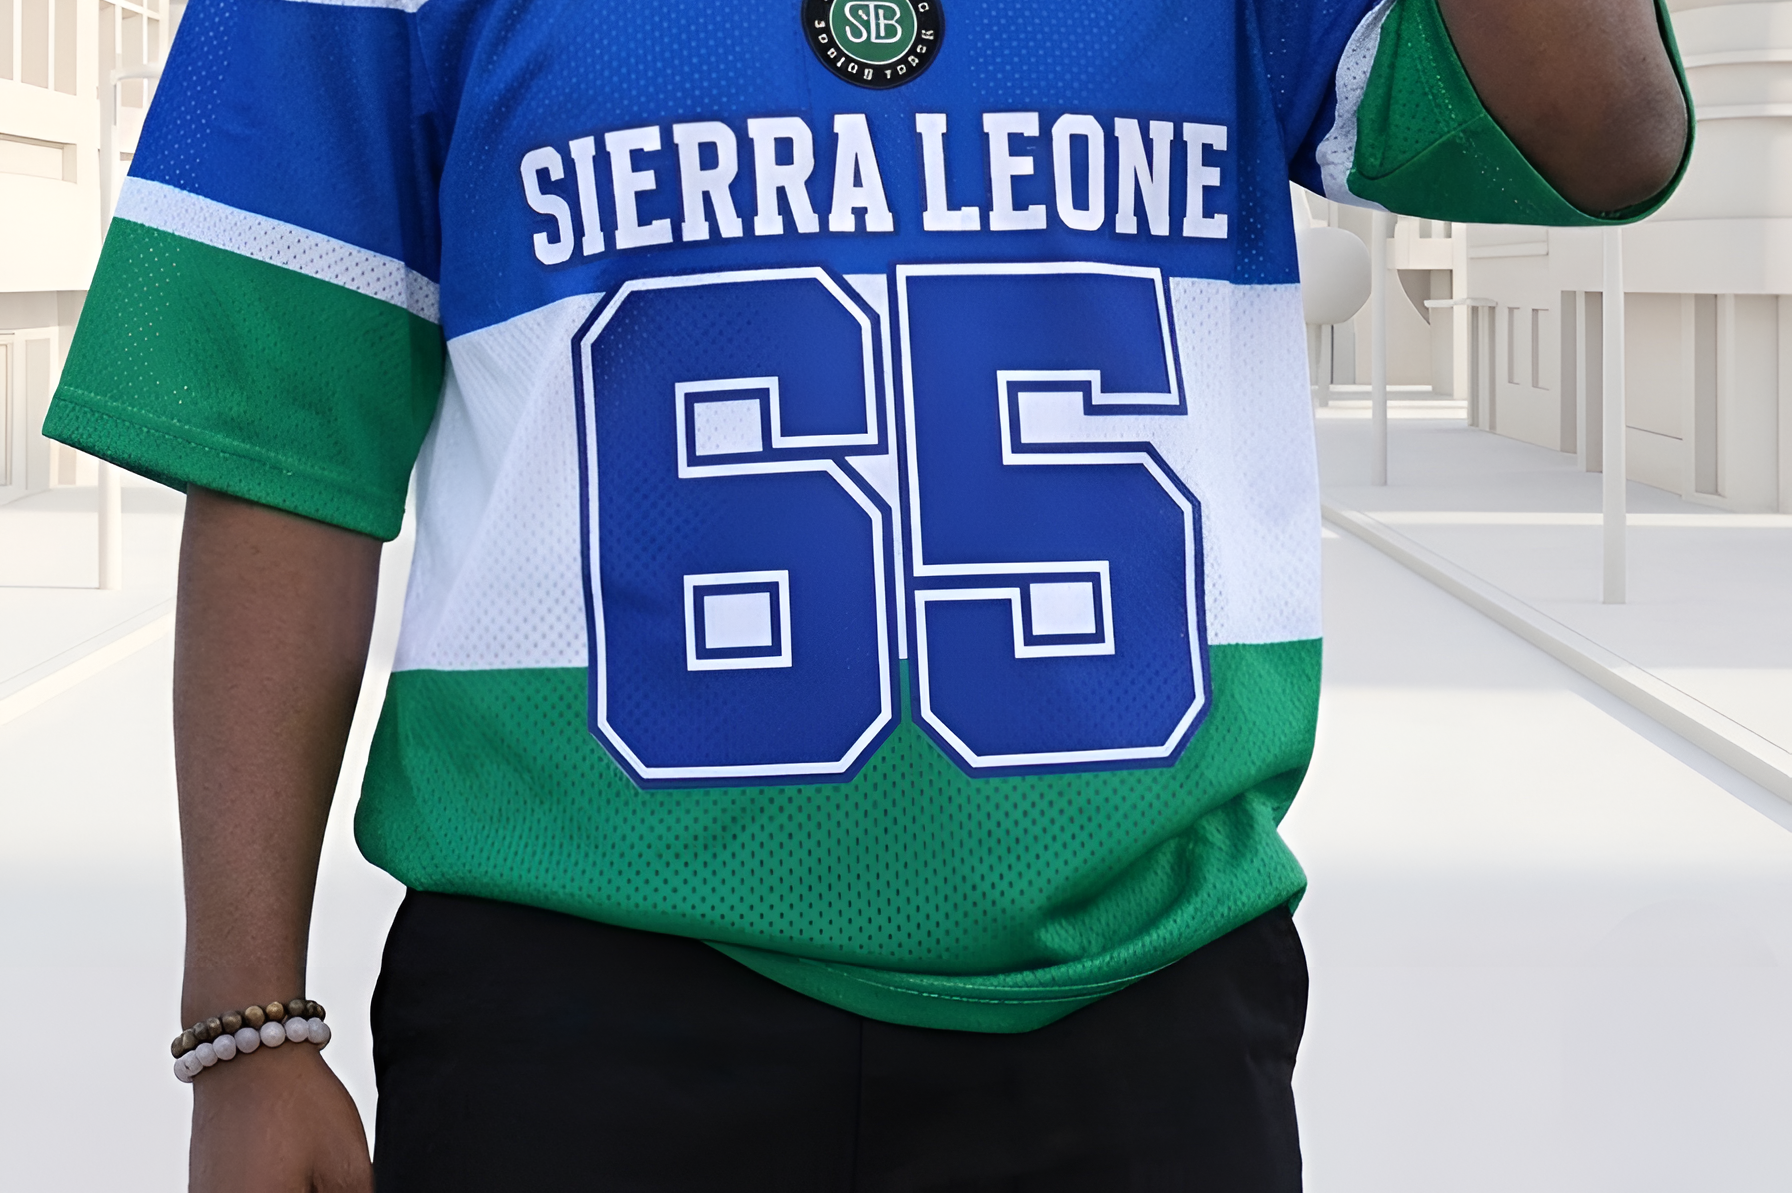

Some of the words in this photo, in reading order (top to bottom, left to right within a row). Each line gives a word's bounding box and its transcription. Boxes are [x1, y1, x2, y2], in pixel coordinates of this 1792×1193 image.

[520, 112, 895, 266] SIERRA
[915, 111, 1229, 239] LEONE
[571, 261, 1213, 790] 65
